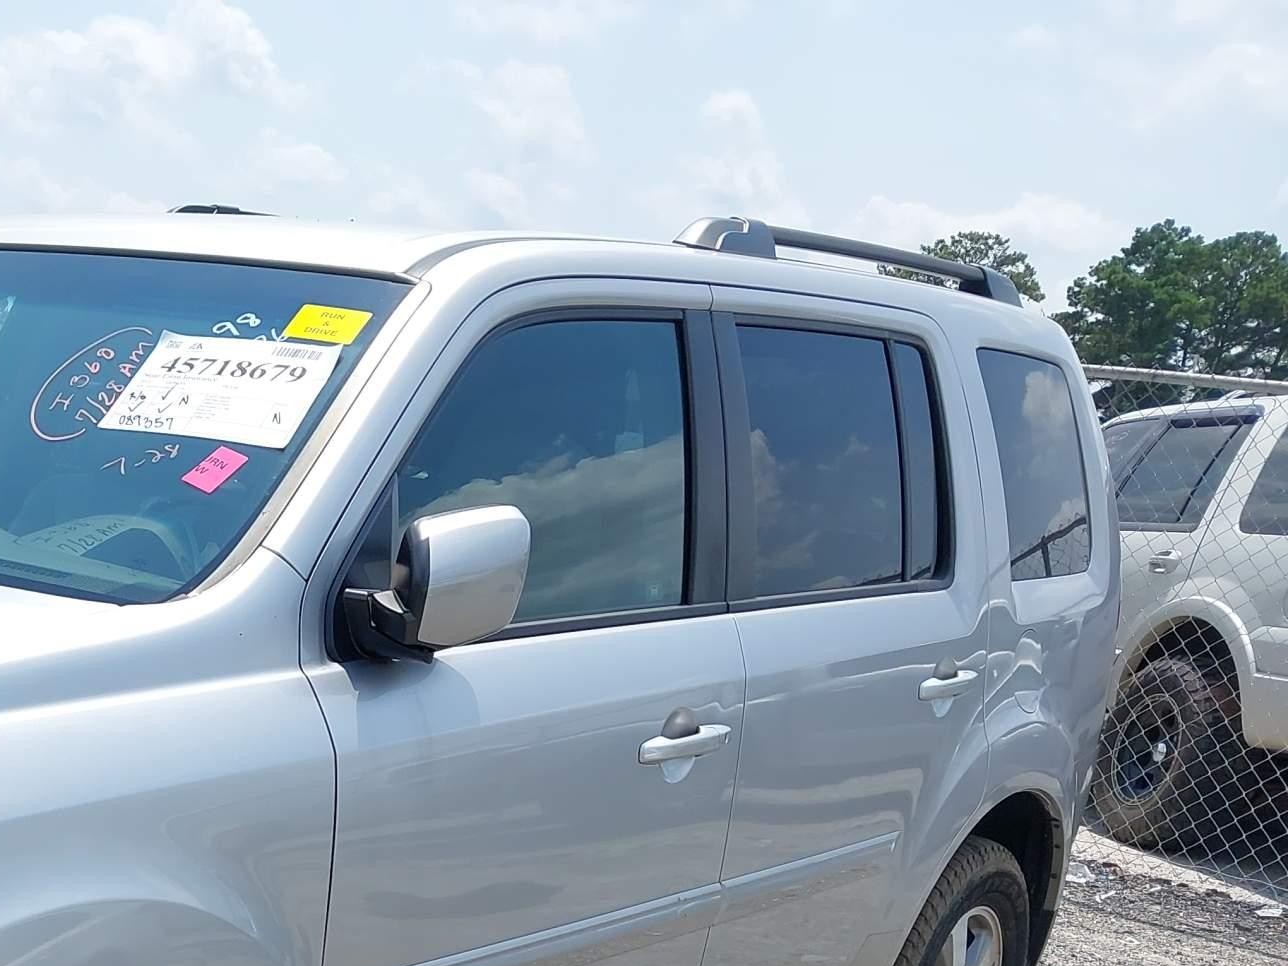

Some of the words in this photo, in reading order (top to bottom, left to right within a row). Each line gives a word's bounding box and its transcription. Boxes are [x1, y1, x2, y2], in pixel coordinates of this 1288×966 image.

[320, 311, 346, 321] RUN
[303, 326, 339, 337] DRIVE
[160, 355, 309, 384] 45718679
